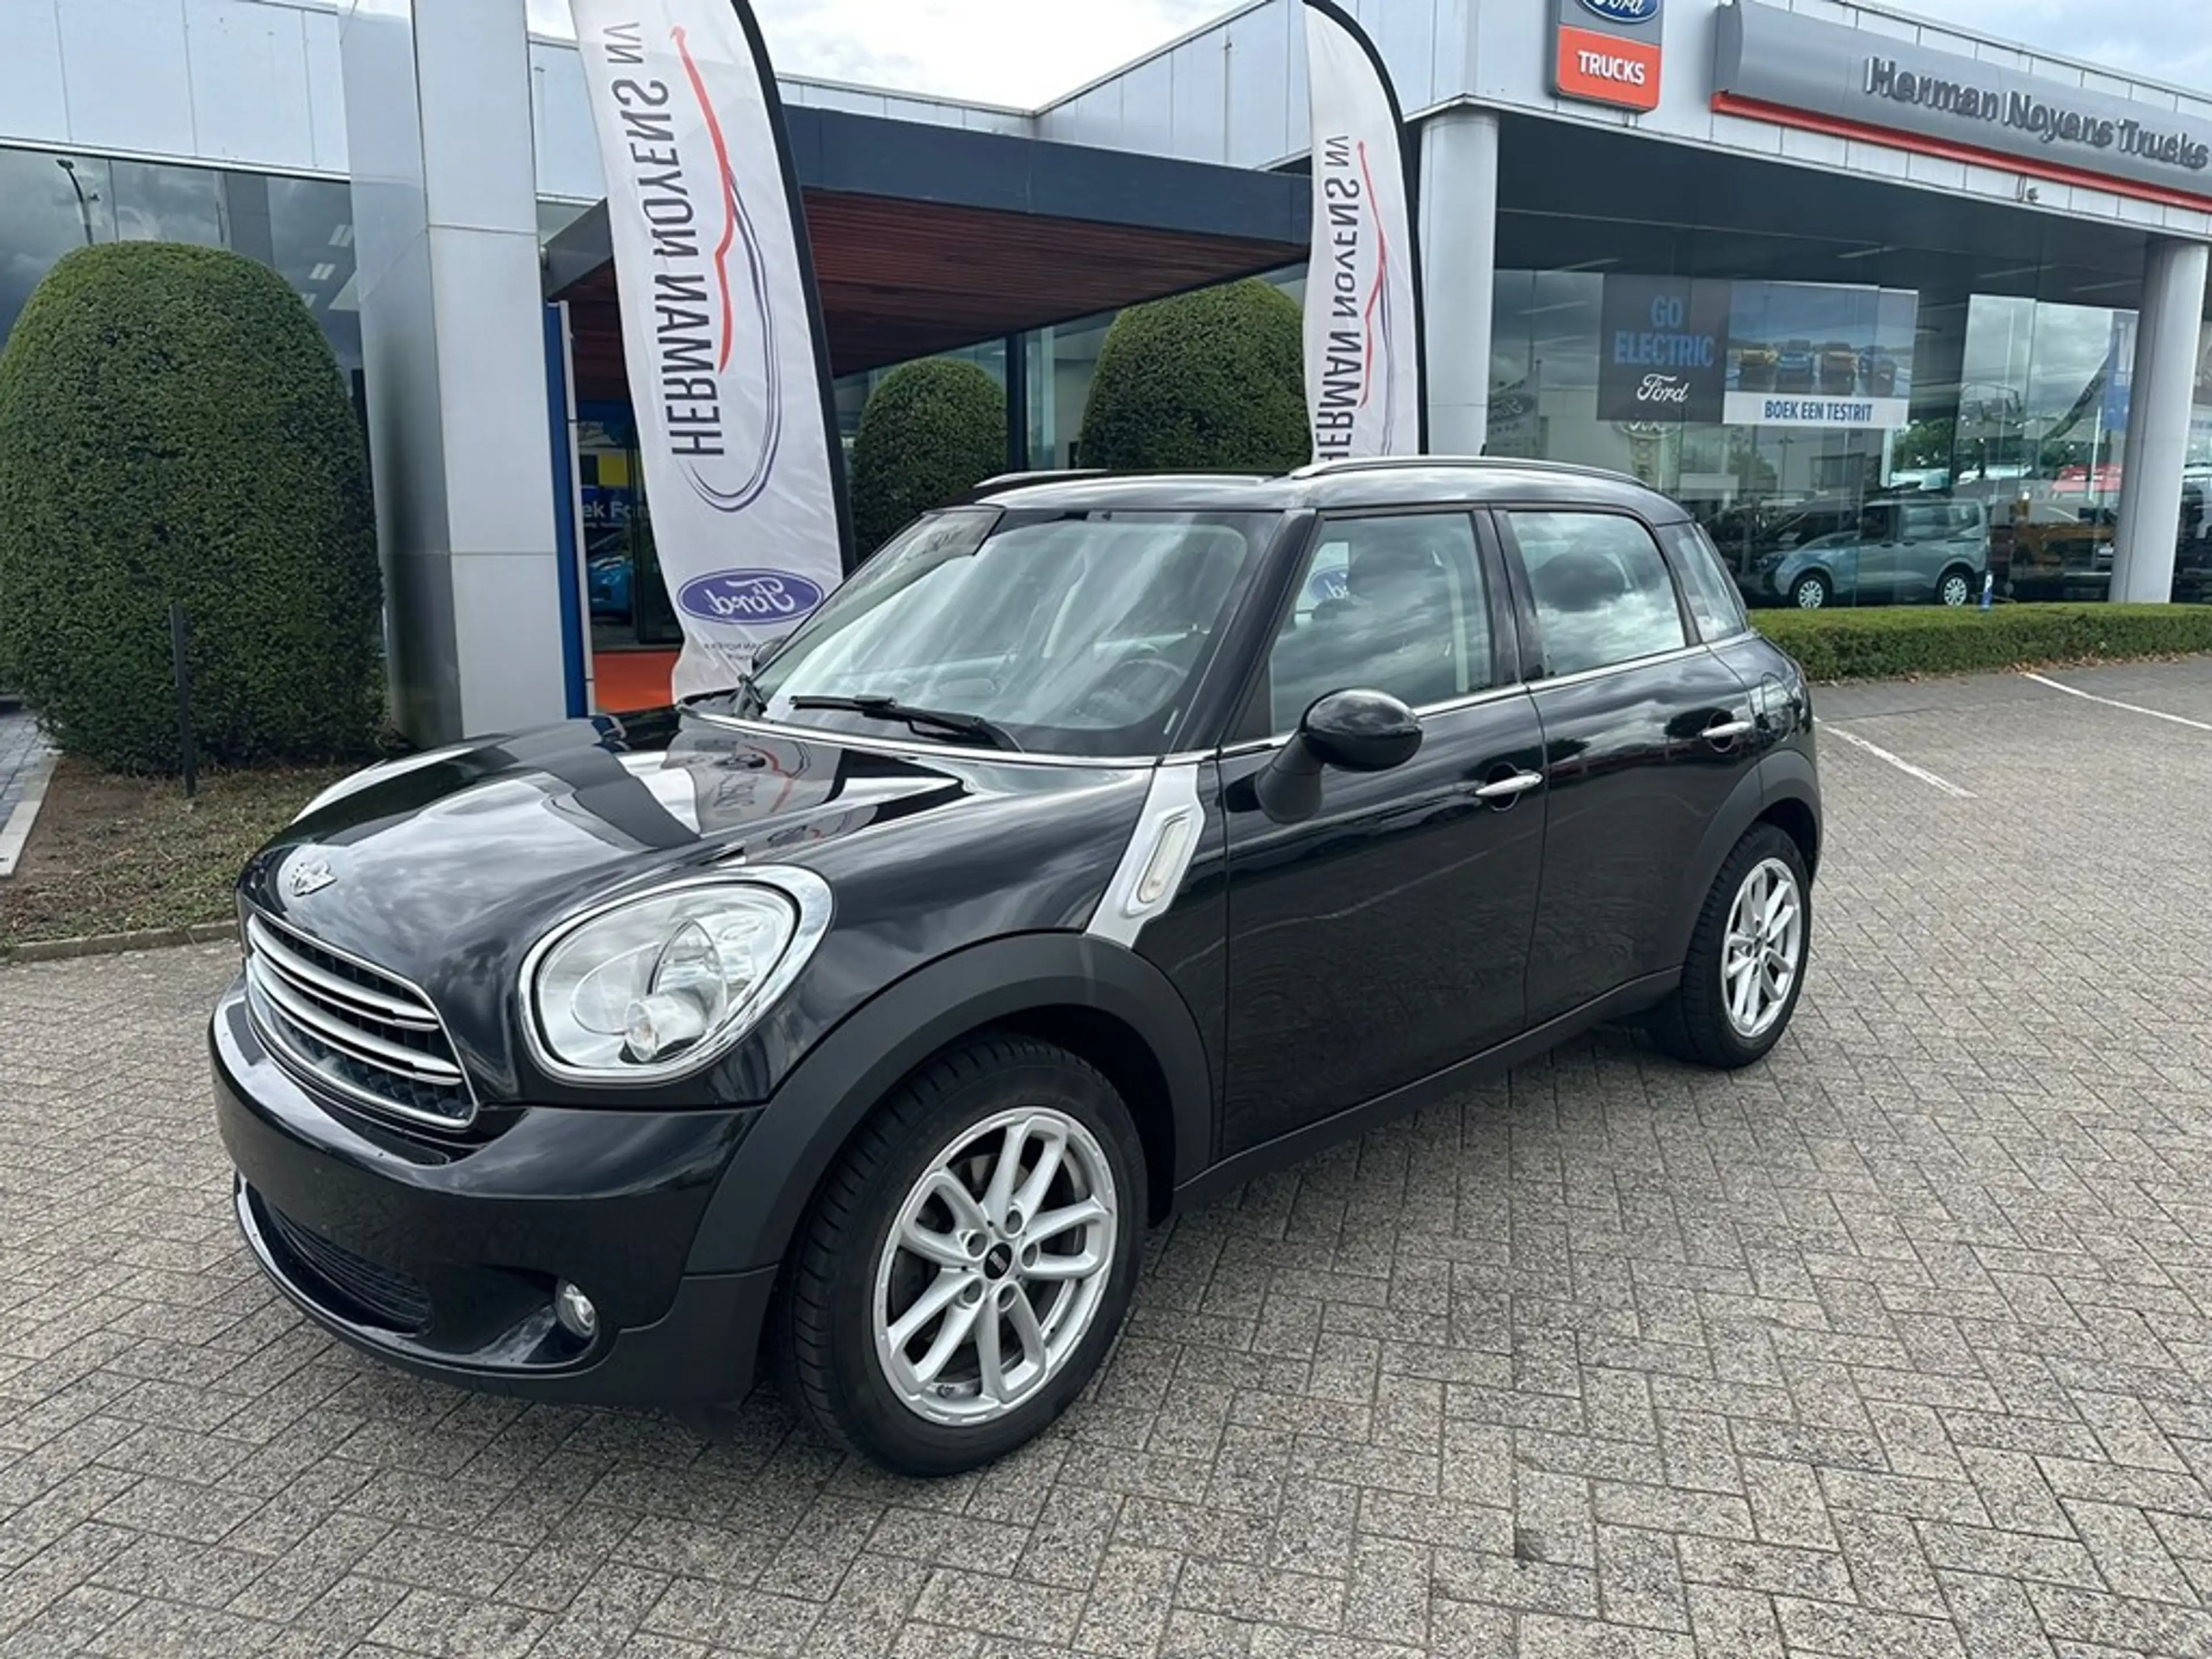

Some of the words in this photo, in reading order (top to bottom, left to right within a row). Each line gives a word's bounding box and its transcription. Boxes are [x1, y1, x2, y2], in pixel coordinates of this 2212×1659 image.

[1578, 50, 1646, 86] TRUCKS
[1863, 56, 1999, 121] Herman
[2002, 90, 2113, 143] Noyens
[2117, 119, 2209, 170] Trucks
[1650, 294, 1683, 329] GO
[1614, 330, 1715, 368] ELECTRIC
[1637, 373, 1690, 403] Ford
[1764, 400, 1798, 419] BOEK
[1801, 401, 1824, 420] EEN
[1827, 402, 1873, 422] TESTRIT
